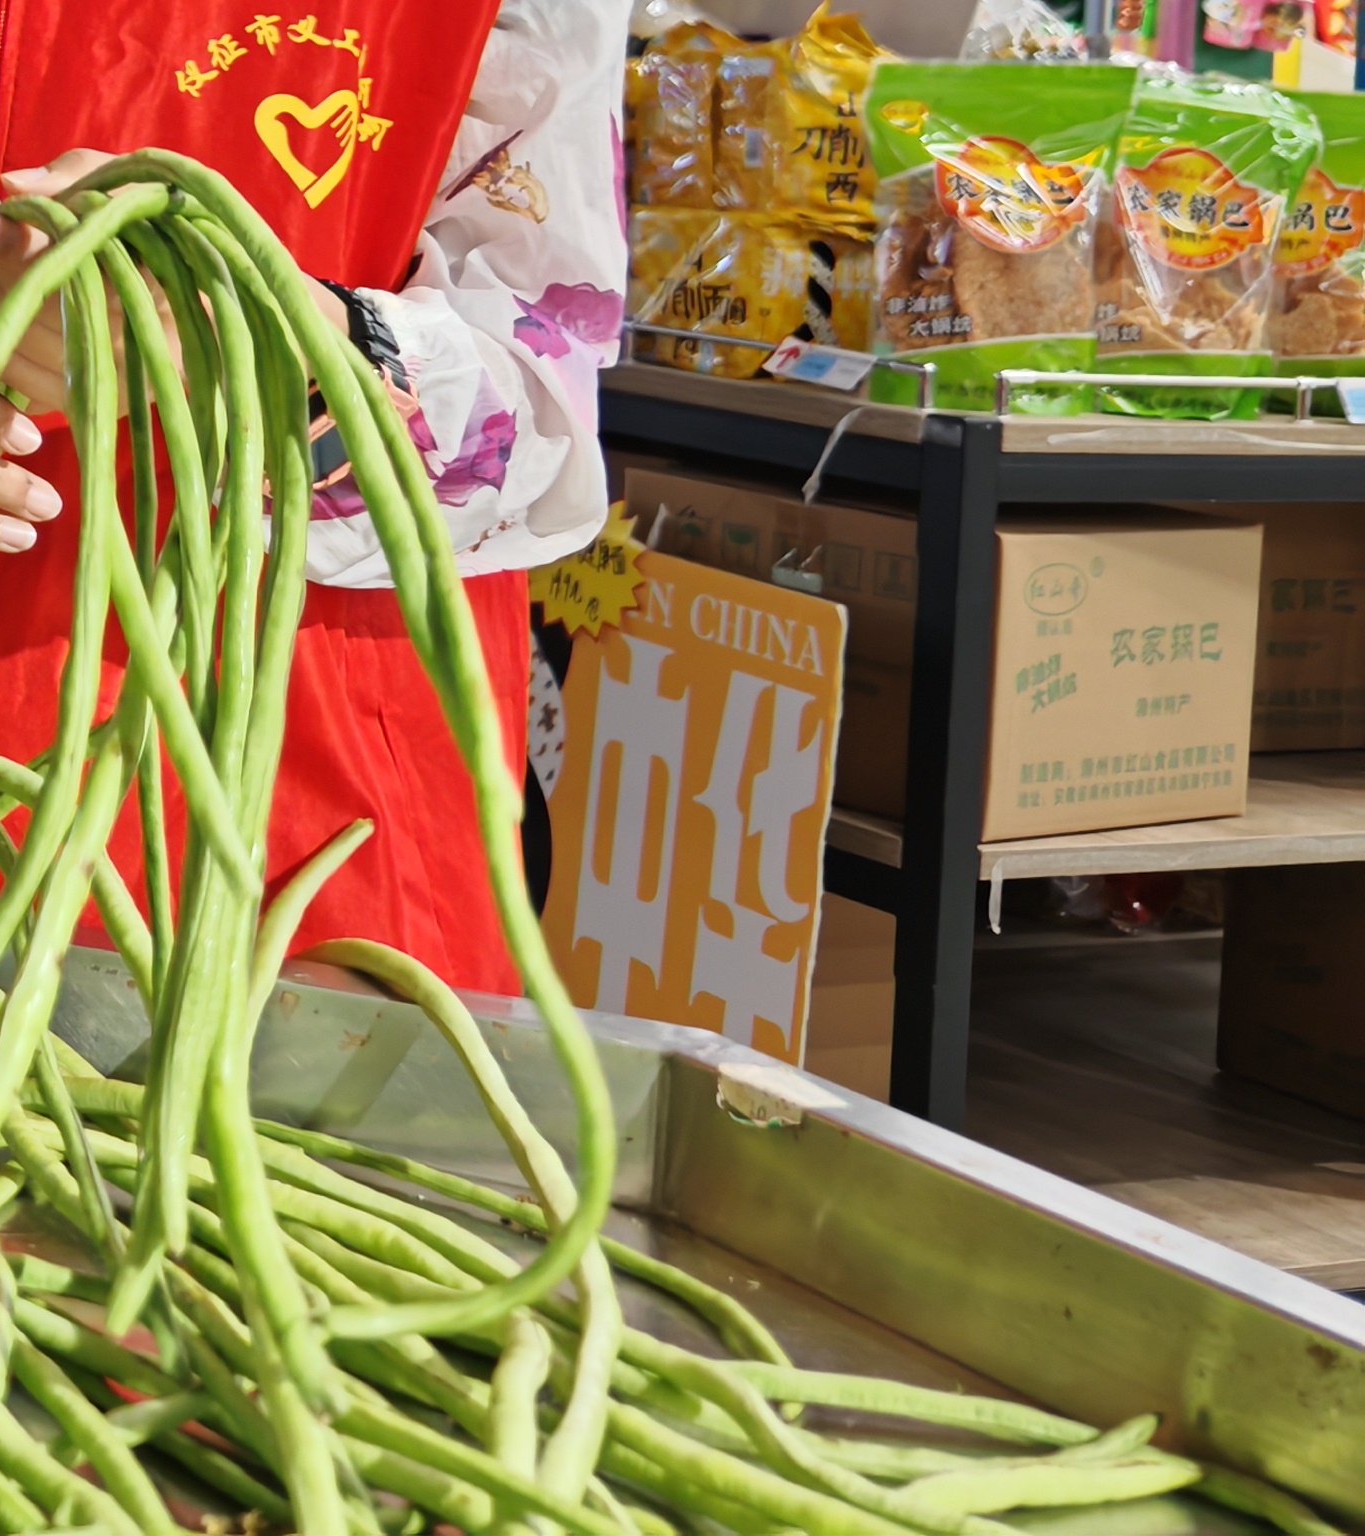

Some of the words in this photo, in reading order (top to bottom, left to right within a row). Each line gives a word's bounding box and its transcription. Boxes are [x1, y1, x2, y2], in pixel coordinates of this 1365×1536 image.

[689, 593, 826, 678] CHINA
[1110, 622, 1223, 668] 农家锅巴
